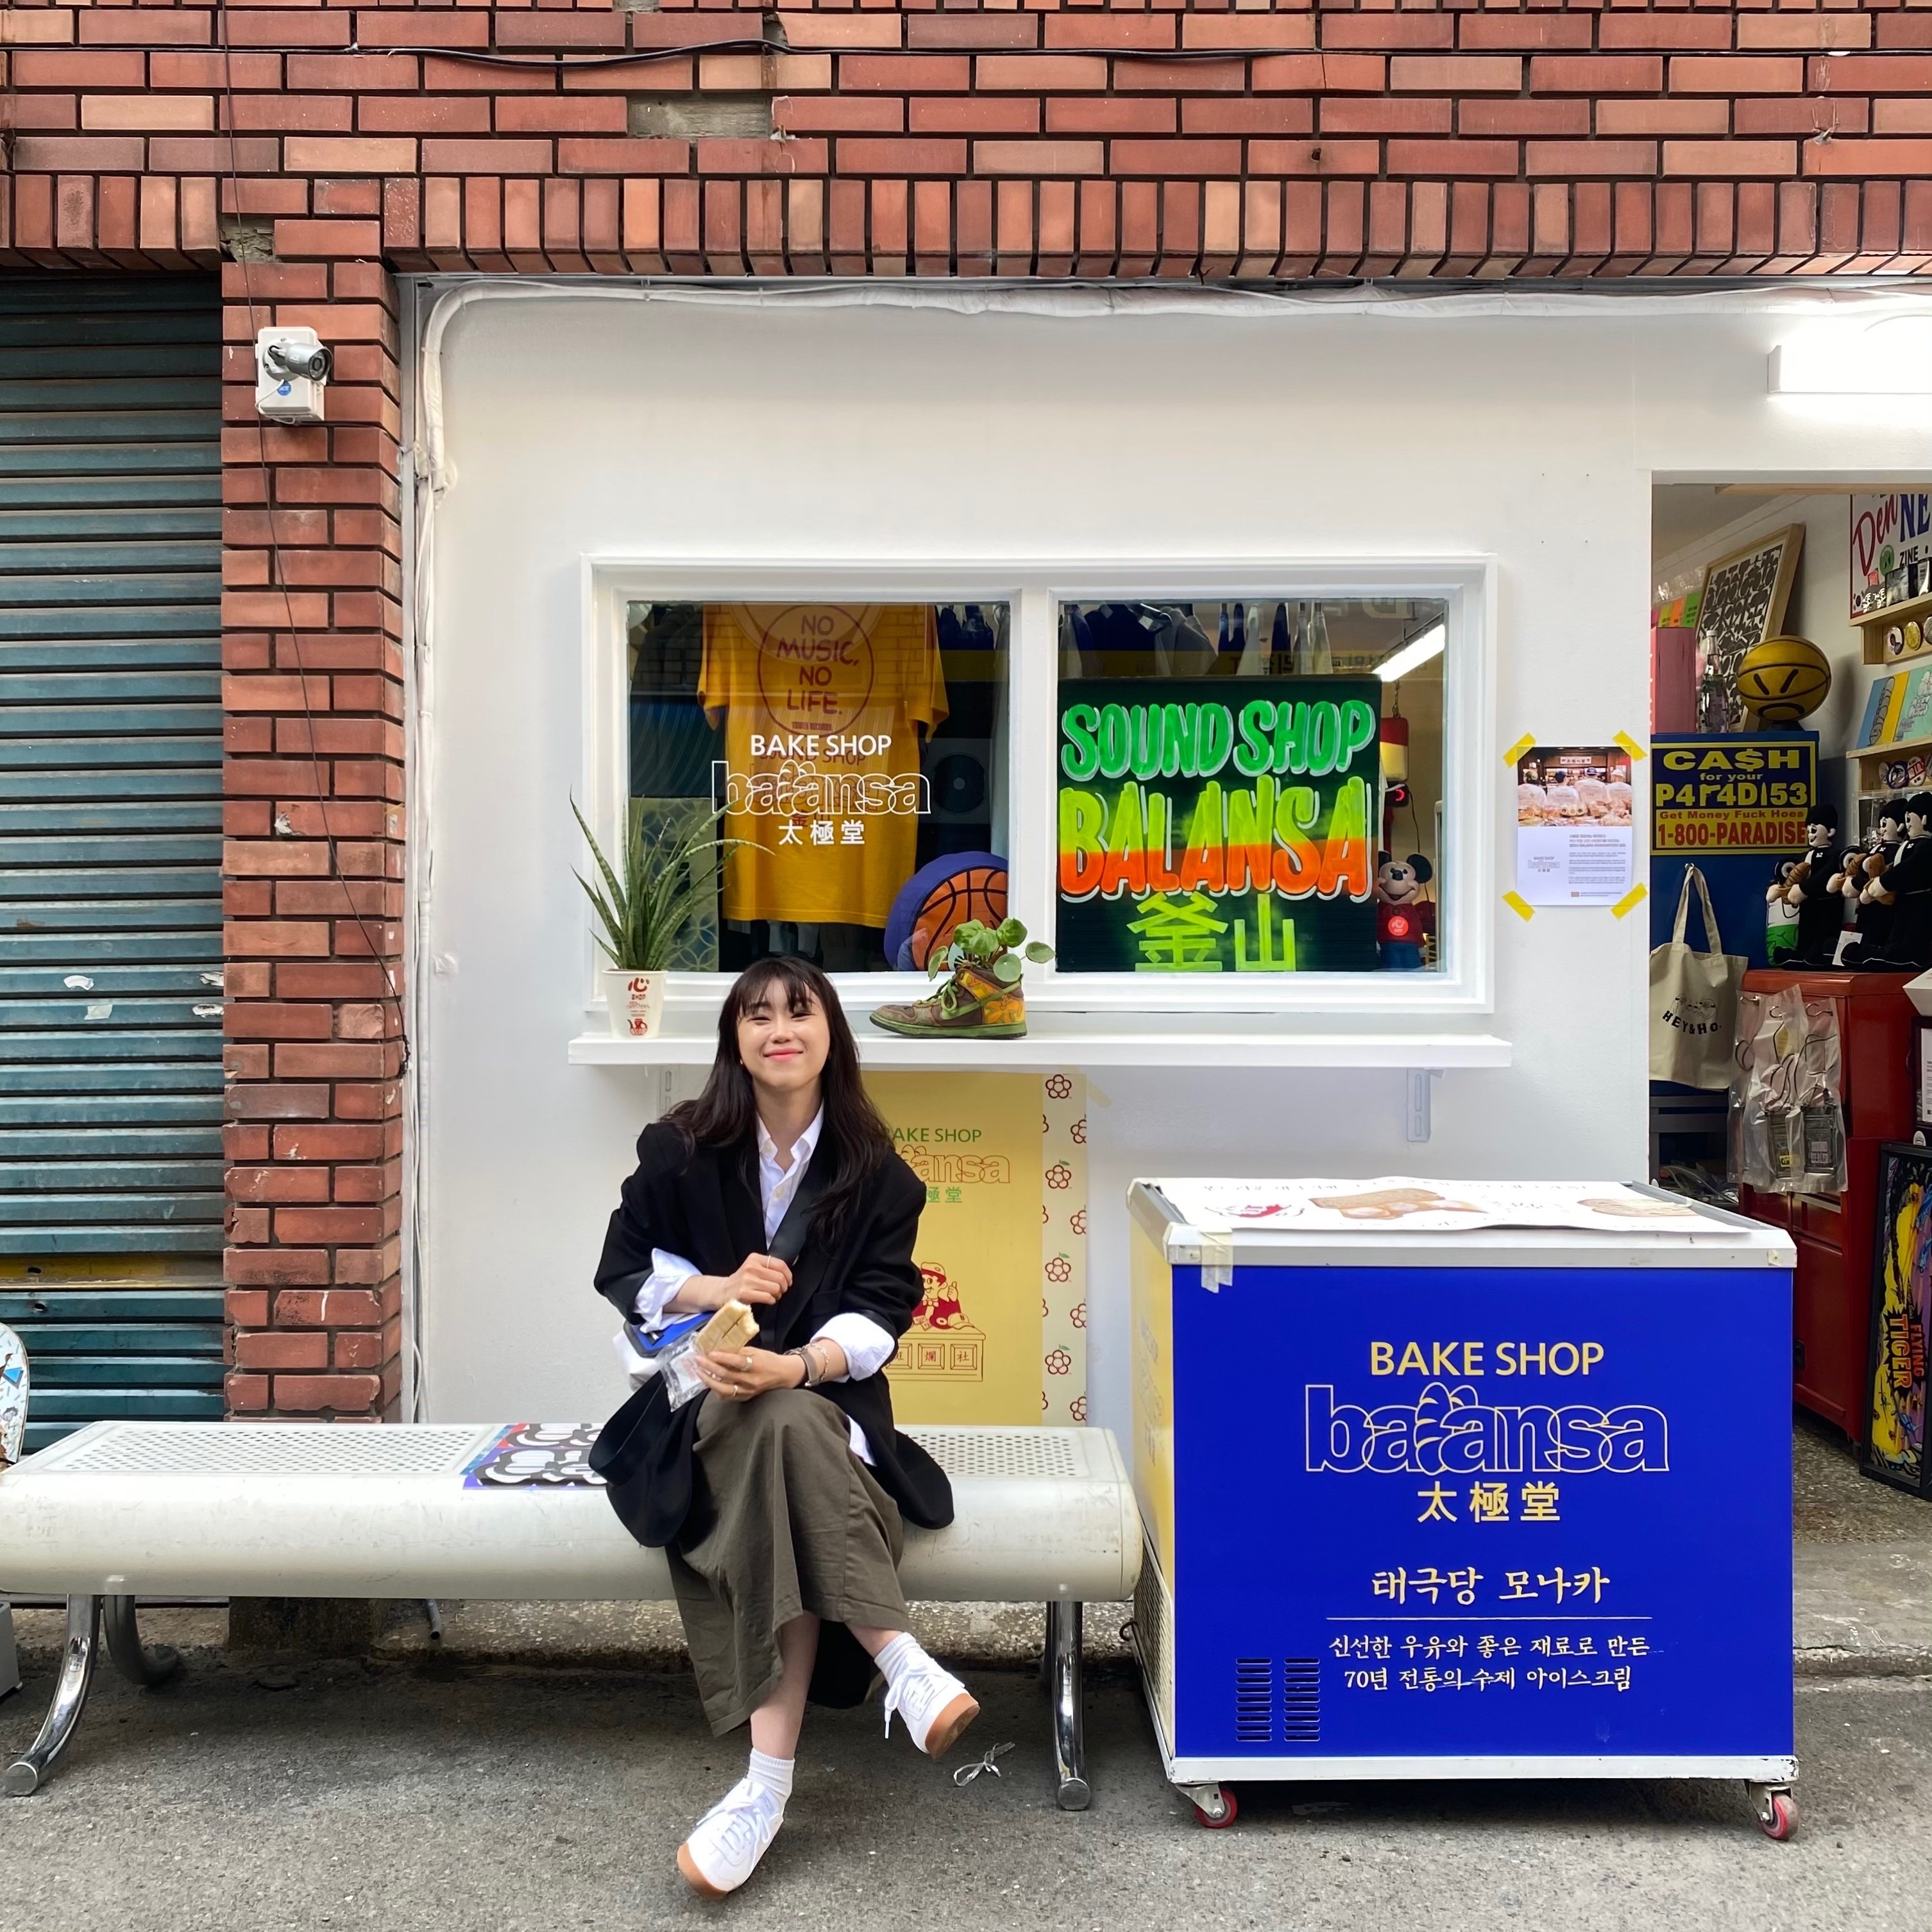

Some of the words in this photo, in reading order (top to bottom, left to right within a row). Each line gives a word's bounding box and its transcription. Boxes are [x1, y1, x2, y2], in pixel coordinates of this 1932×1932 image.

[1899, 546, 1919, 568] ZINE
[802, 615, 834, 636] NO
[777, 638, 860, 666] MUSIC,
[799, 666, 832, 686] NO
[787, 689, 842, 715] LIFE.
[750, 734, 820, 756] BAKE
[826, 734, 892, 756] SHOP
[1060, 702, 1233, 781] SOUND
[1233, 699, 1376, 778] SHOP
[1663, 749, 1800, 772] CA$H
[1727, 774, 1763, 783] your
[1659, 811, 1683, 820] Get
[1687, 810, 1730, 822] Money
[1734, 809, 1767, 818] Fuck
[1771, 809, 1804, 818] Hoes
[779, 819, 865, 845] 太極堂
[1058, 774, 1372, 902] BALANSA
[1658, 821, 1807, 846] 1-800-PARADISE
[1126, 890, 1296, 972] 釜山
[891, 1128, 929, 1142] AKE
[934, 1128, 982, 1142] SHOP
[1371, 1341, 1485, 1376] BAKE
[1495, 1341, 1605, 1376] SHOP
[1890, 1314, 1912, 1388] TIGER
[1910, 1325, 1925, 1377] FLYING
[1417, 1480, 1561, 1523] 太極堂
[1371, 1566, 1484, 1606] 태극당
[1498, 1566, 1611, 1605] 모나카
[1328, 1634, 1393, 1660] 신선한
[1400, 1635, 1469, 1660] 우유와
[1476, 1635, 1522, 1659] 좋은
[1529, 1635, 1598, 1658] 재료로
[1607, 1635, 1650, 1658] 만든
[1344, 1666, 1389, 1691] 70년
[1398, 1666, 1463, 1692] 전통의
[1470, 1666, 1516, 1692] 수제
[1526, 1665, 1632, 1692] 아이스크림
